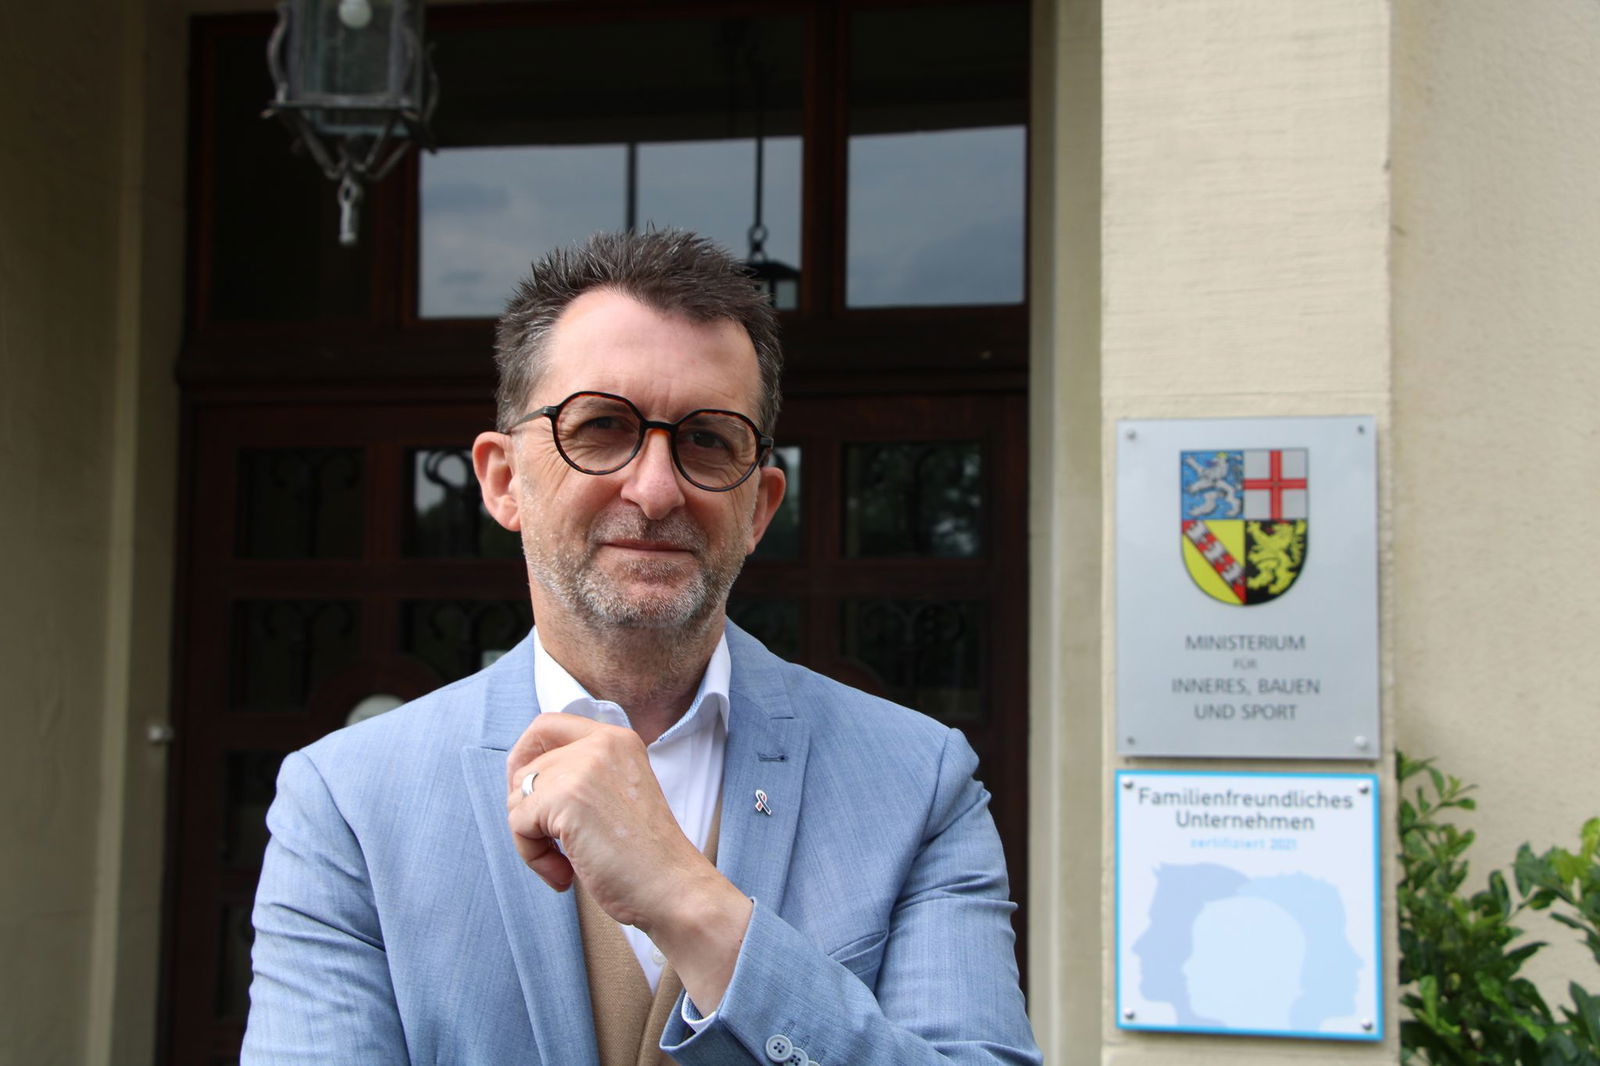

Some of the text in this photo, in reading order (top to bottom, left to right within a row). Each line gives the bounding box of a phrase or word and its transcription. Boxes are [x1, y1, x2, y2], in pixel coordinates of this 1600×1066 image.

[1185, 635, 1306, 650] MINISTERIUM
[1233, 657, 1258, 670] FÜR
[1172, 678, 1320, 695] INNERES, BAUEN
[1194, 704, 1297, 720] UND SPORT
[1138, 787, 1354, 810] Familienfreundliches
[1175, 811, 1315, 830] Unternehmen
[1270, 838, 1297, 850] 2021
